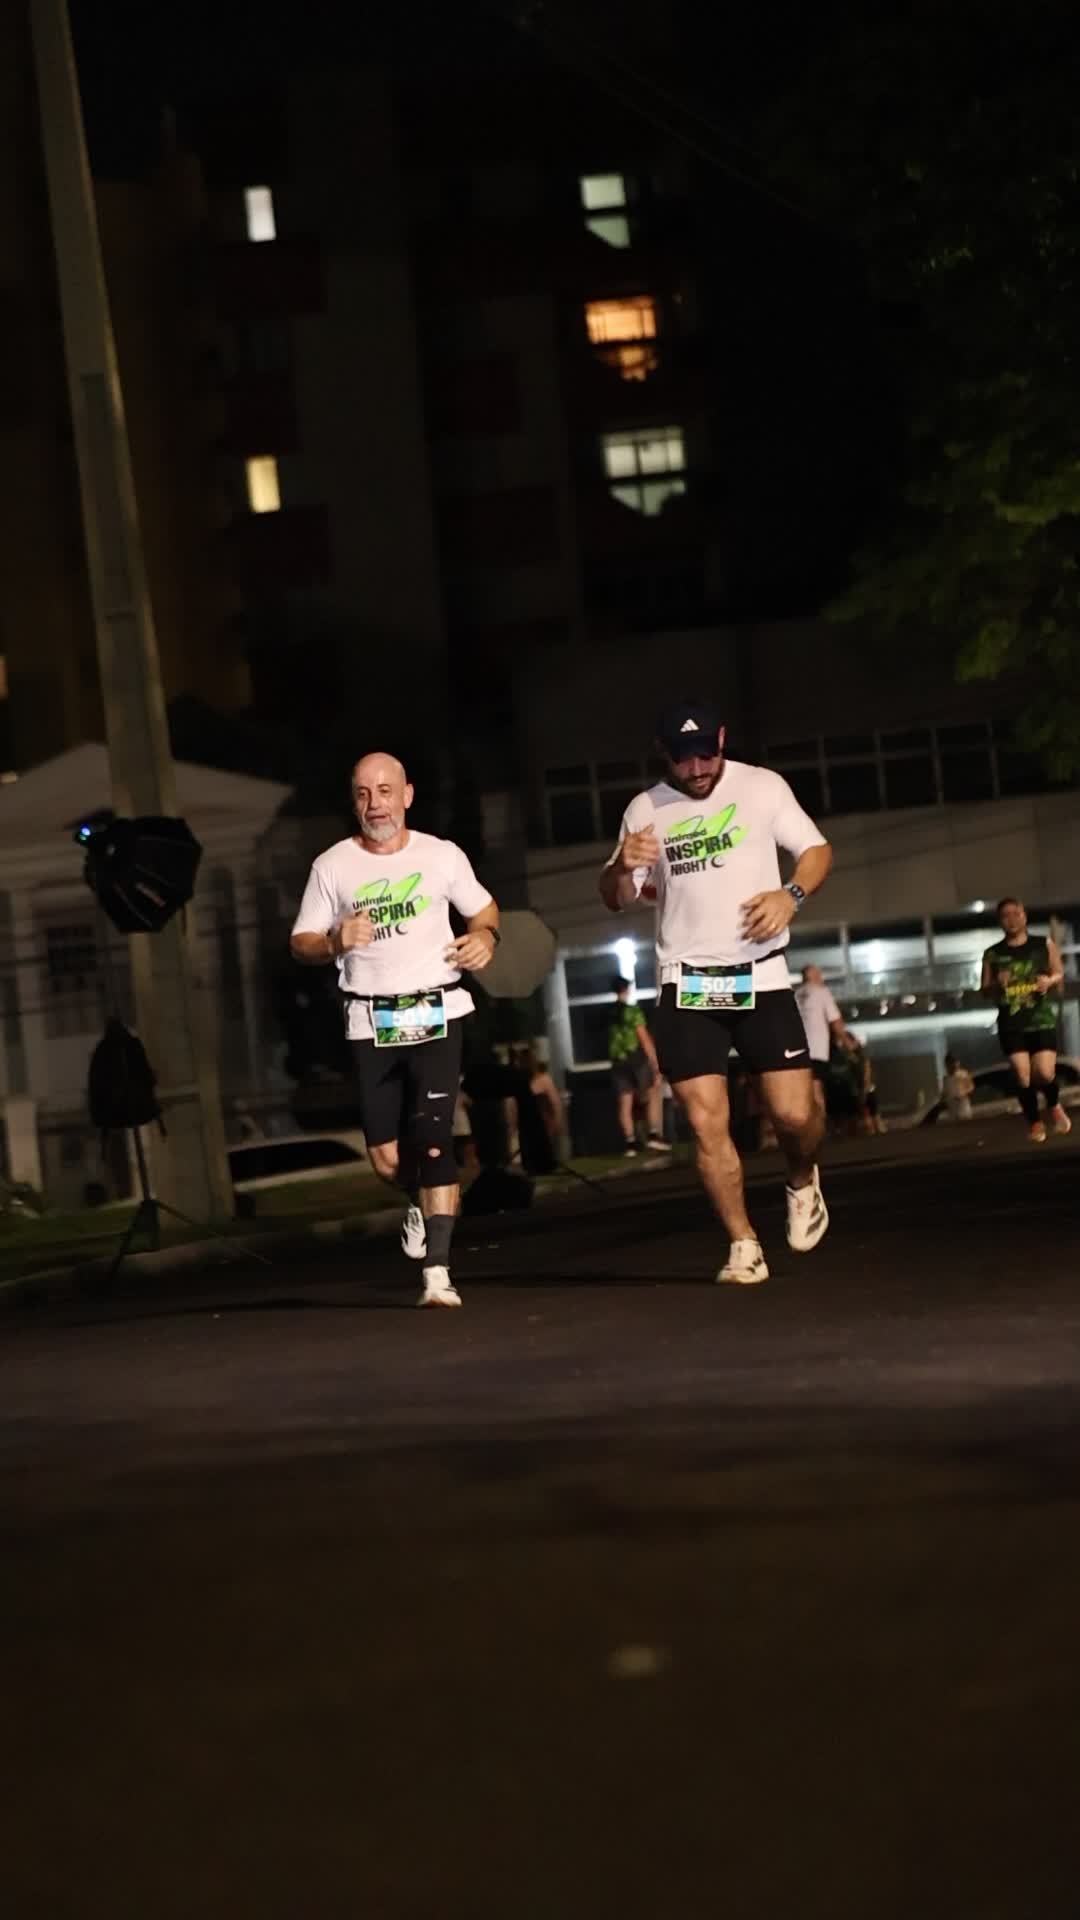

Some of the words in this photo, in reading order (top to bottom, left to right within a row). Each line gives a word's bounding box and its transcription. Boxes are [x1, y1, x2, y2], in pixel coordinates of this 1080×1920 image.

[663, 828, 707, 845] Unimed
[665, 832, 733, 862] INSPIRA
[670, 859, 707, 877] NIGHT
[352, 893, 393, 910] Unimed
[354, 901, 417, 925] SPIRA
[702, 975, 737, 994] 502
